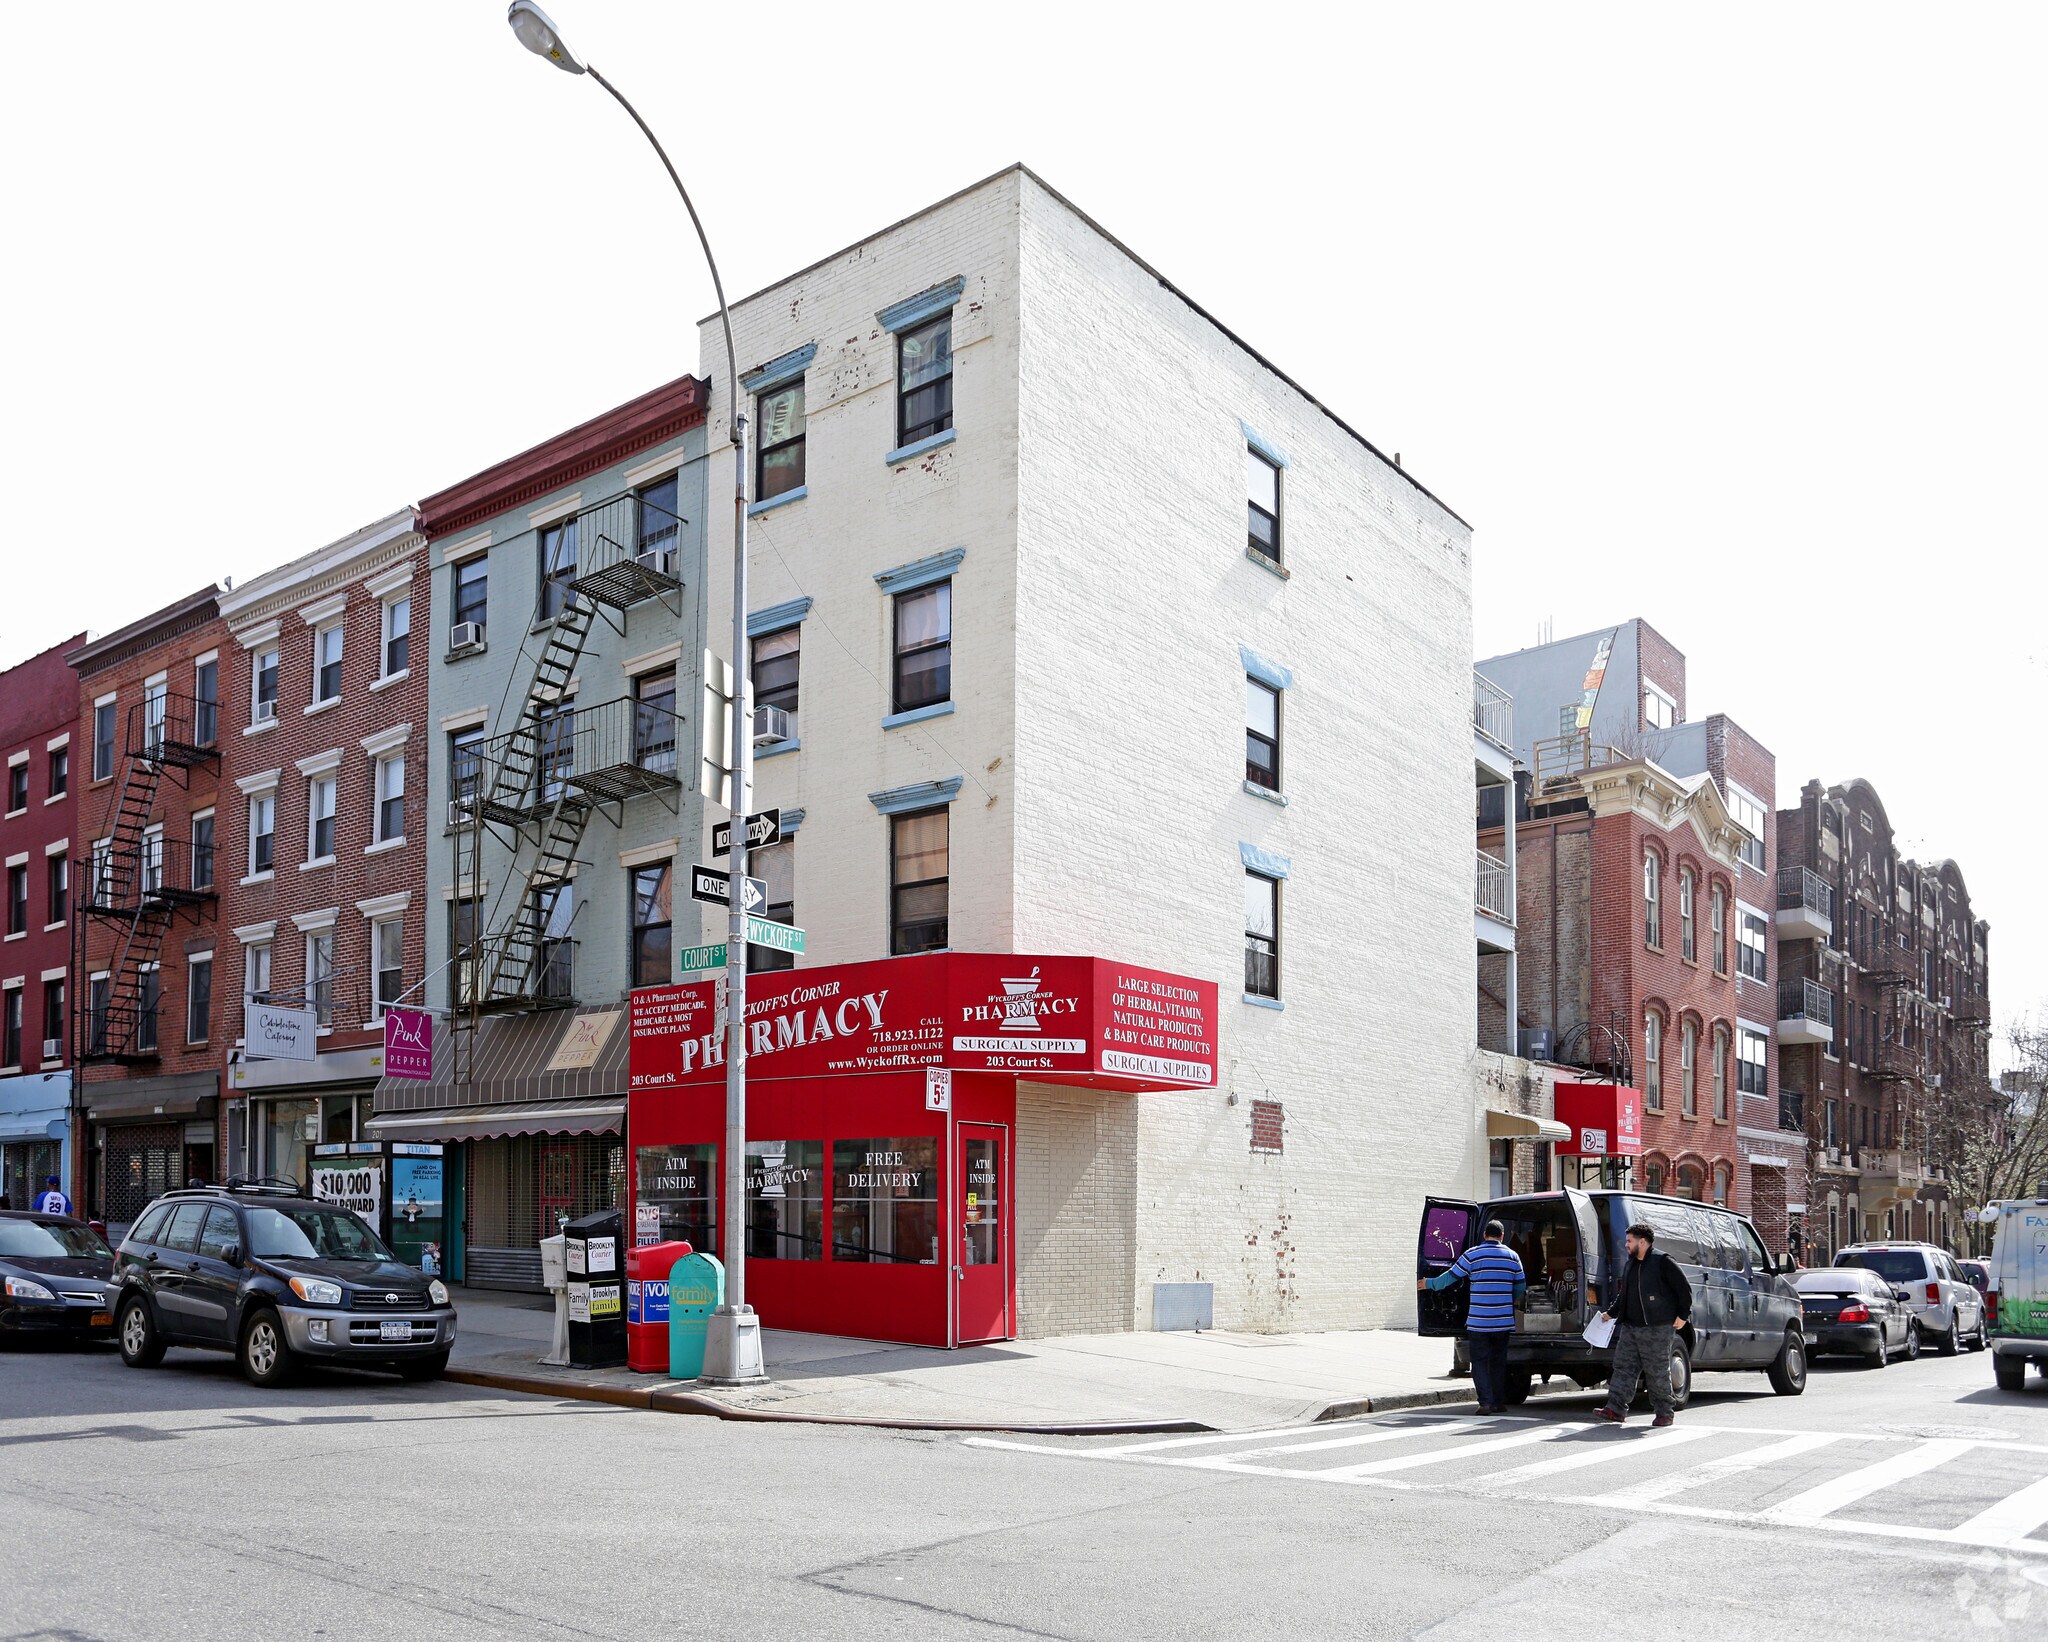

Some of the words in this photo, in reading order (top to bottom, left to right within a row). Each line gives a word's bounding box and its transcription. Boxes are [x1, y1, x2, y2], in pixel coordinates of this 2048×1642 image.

[749, 822, 769, 838] WAY
[703, 878, 724, 894] ONE
[750, 921, 793, 949] WYCKOFF
[794, 933, 802, 943] ST
[684, 947, 714, 969] COURT
[715, 946, 725, 956] ST
[1118, 976, 1149, 993] LARGE
[1151, 982, 1199, 1002] SELECTION
[633, 996, 638, 1005] O
[640, 996, 645, 1004] &
[646, 995, 651, 1003] A
[652, 992, 680, 1003] Pharmacy
[681, 990, 698, 1001] Corp.
[742, 994, 788, 1018] CKOFF'S
[790, 981, 840, 1005] CORNER
[988, 994, 1025, 1003] WYCKOFF'S
[1026, 990, 1053, 1000] CORNER
[1112, 993, 1125, 1006] OF
[634, 1008, 644, 1016] WE
[645, 1005, 670, 1015] ACCEPT
[670, 1001, 707, 1011] MEDICADE,
[962, 998, 1079, 1021] PHARMACY
[634, 1016, 667, 1027] MEDICARE
[667, 1015, 673, 1023] &
[674, 1013, 693, 1022] MOST
[921, 1017, 943, 1025] CALL
[1114, 1011, 1156, 1029] NATURAL
[1158, 1018, 1203, 1037] PRODUCTS
[387, 1014, 429, 1050] Pink
[634, 1026, 668, 1037] INSURANCE
[670, 1023, 690, 1033] PLANS
[681, 990, 888, 1074] PHRMACY
[873, 1028, 943, 1042] 718.923.1122
[265, 1029, 296, 1048] Catering
[960, 1039, 1027, 1050] SURGICAL
[1030, 1040, 1077, 1051] SUPPLY
[1104, 1027, 1111, 1040] &
[1114, 1029, 1138, 1044] BABY
[1141, 1033, 1164, 1048] CARE
[1167, 1038, 1210, 1055] PRODUCTS
[867, 1046, 878, 1054] OR
[881, 1044, 908, 1053] ORDER
[911, 1041, 943, 1050] ONLINE
[390, 1055, 427, 1067] PEPPER
[559, 1052, 593, 1062] PEPPER
[828, 1053, 943, 1069] www.WyckoffRx.com
[986, 1056, 1004, 1066] 203
[1007, 1057, 1037, 1067] Court
[1040, 1057, 1053, 1067] St.
[1107, 1054, 1160, 1073] SURGICAL
[1163, 1062, 1207, 1079] SUPPLIES
[632, 1076, 644, 1085] 203
[645, 1073, 665, 1084] Court
[666, 1073, 676, 1082] St.
[930, 1071, 948, 1084] COPIES
[372, 1130, 382, 1139] 201
[357, 1143, 374, 1152] TITAN
[406, 1145, 431, 1154] TITAN
[665, 1158, 687, 1170] ATM
[865, 1152, 903, 1166] FREE
[975, 1160, 990, 1169] ATM
[320, 1172, 371, 1198] $10,000
[658, 1176, 696, 1189] INSIDE
[746, 1169, 809, 1189] HARMACY
[848, 1173, 921, 1187] DELIVERY
[970, 1174, 995, 1183] INSIDE
[50, 1202, 61, 1213] 29
[637, 1208, 658, 1220] CVS
[567, 1240, 585, 1251] BROOKLYN
[589, 1241, 615, 1250] BROOKLYN
[591, 1250, 611, 1259] Courier
[569, 1292, 588, 1306] Family
[593, 1288, 617, 1299] Brooklyn
[671, 1285, 716, 1304] family
[592, 1300, 618, 1312] family
